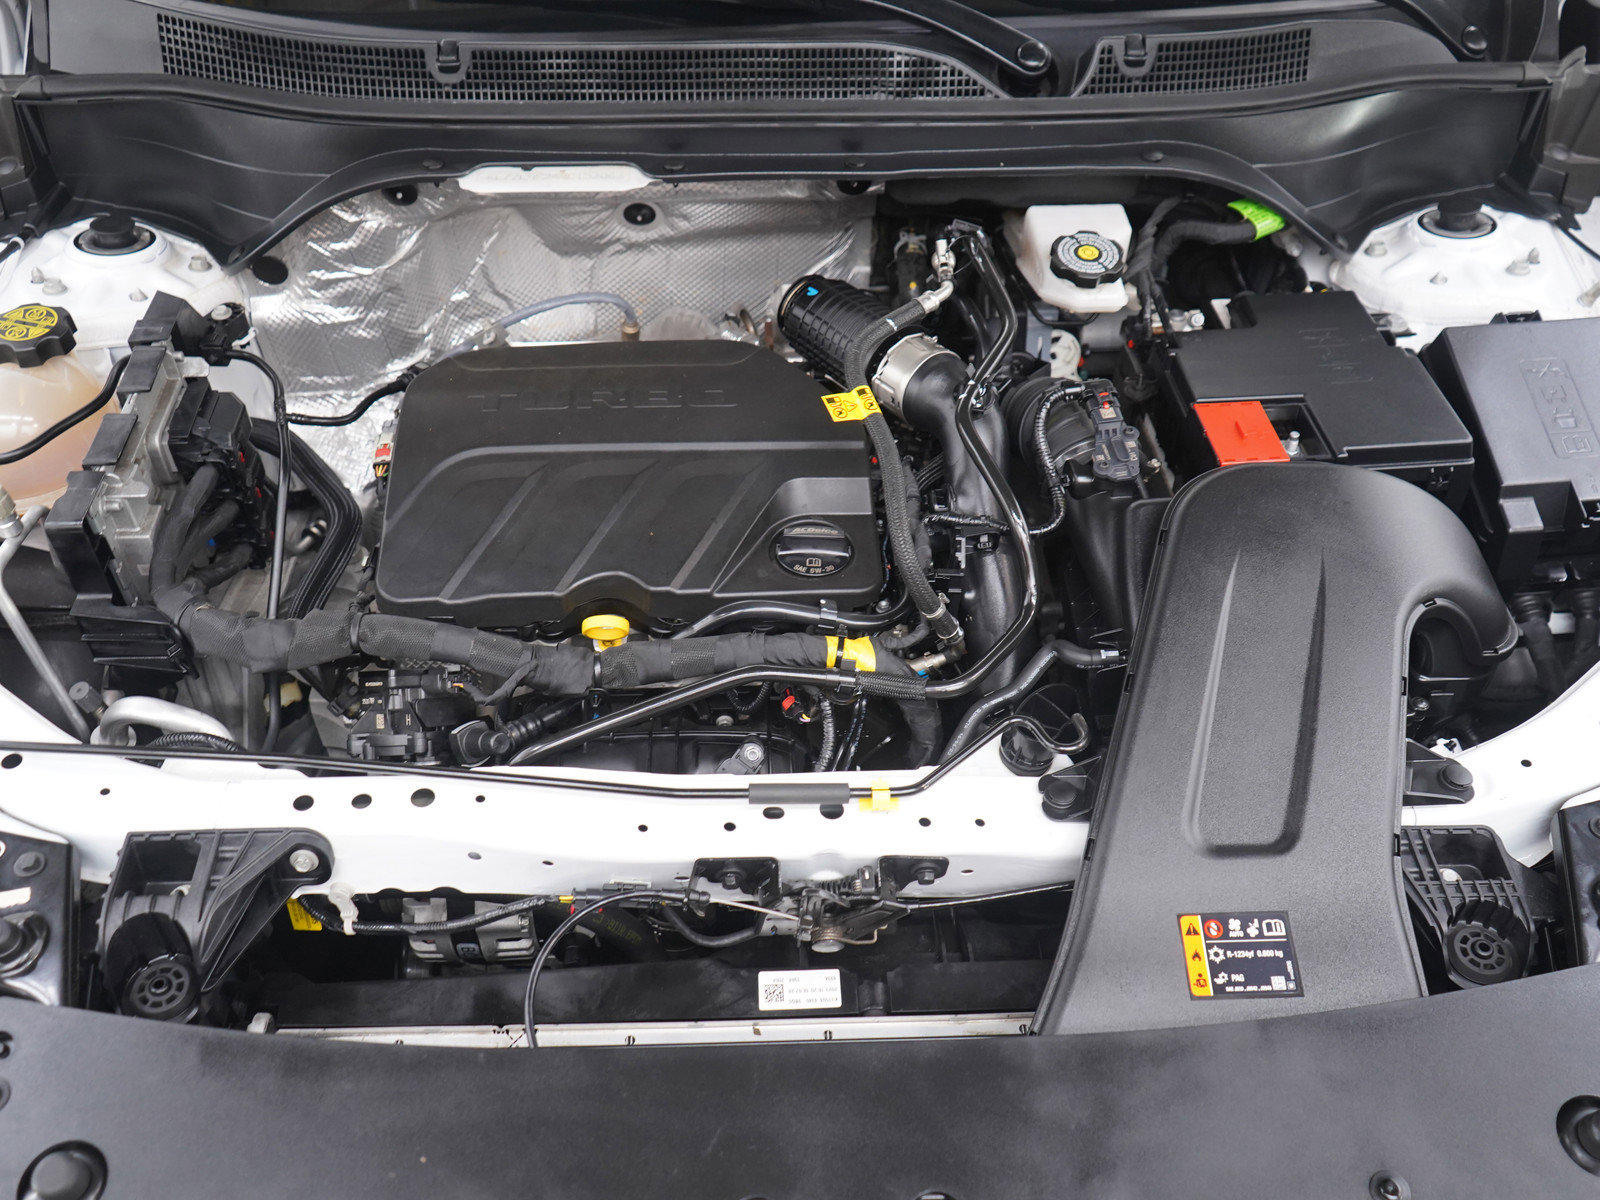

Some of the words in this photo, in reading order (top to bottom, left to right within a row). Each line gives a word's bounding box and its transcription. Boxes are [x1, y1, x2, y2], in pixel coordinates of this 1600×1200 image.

[466, 386, 739, 412] TURBO
[793, 564, 807, 573] SAE
[1274, 949, 1284, 959] kg
[1231, 973, 1245, 982] PAG
